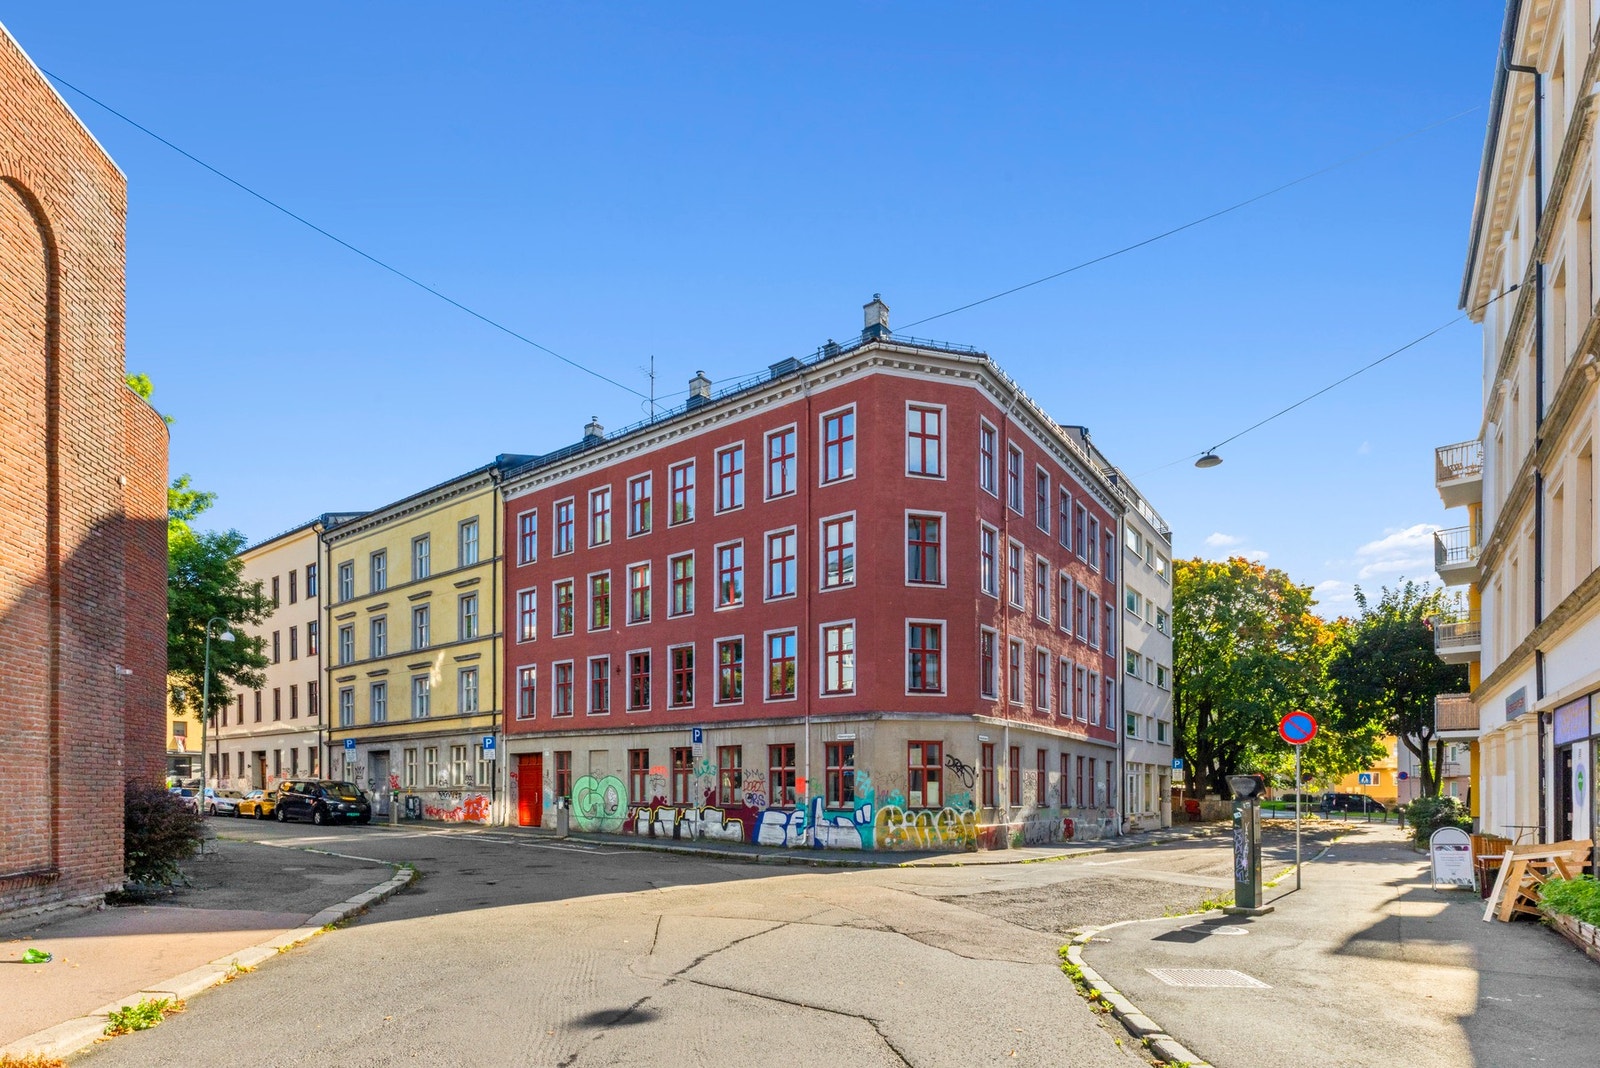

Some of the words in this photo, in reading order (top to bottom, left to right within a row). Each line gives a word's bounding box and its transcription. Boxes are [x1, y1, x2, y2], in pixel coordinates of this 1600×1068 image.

[694, 729, 701, 741] P
[346, 739, 353, 748] P
[485, 738, 493, 748] P
[1174, 760, 1181, 768] P
